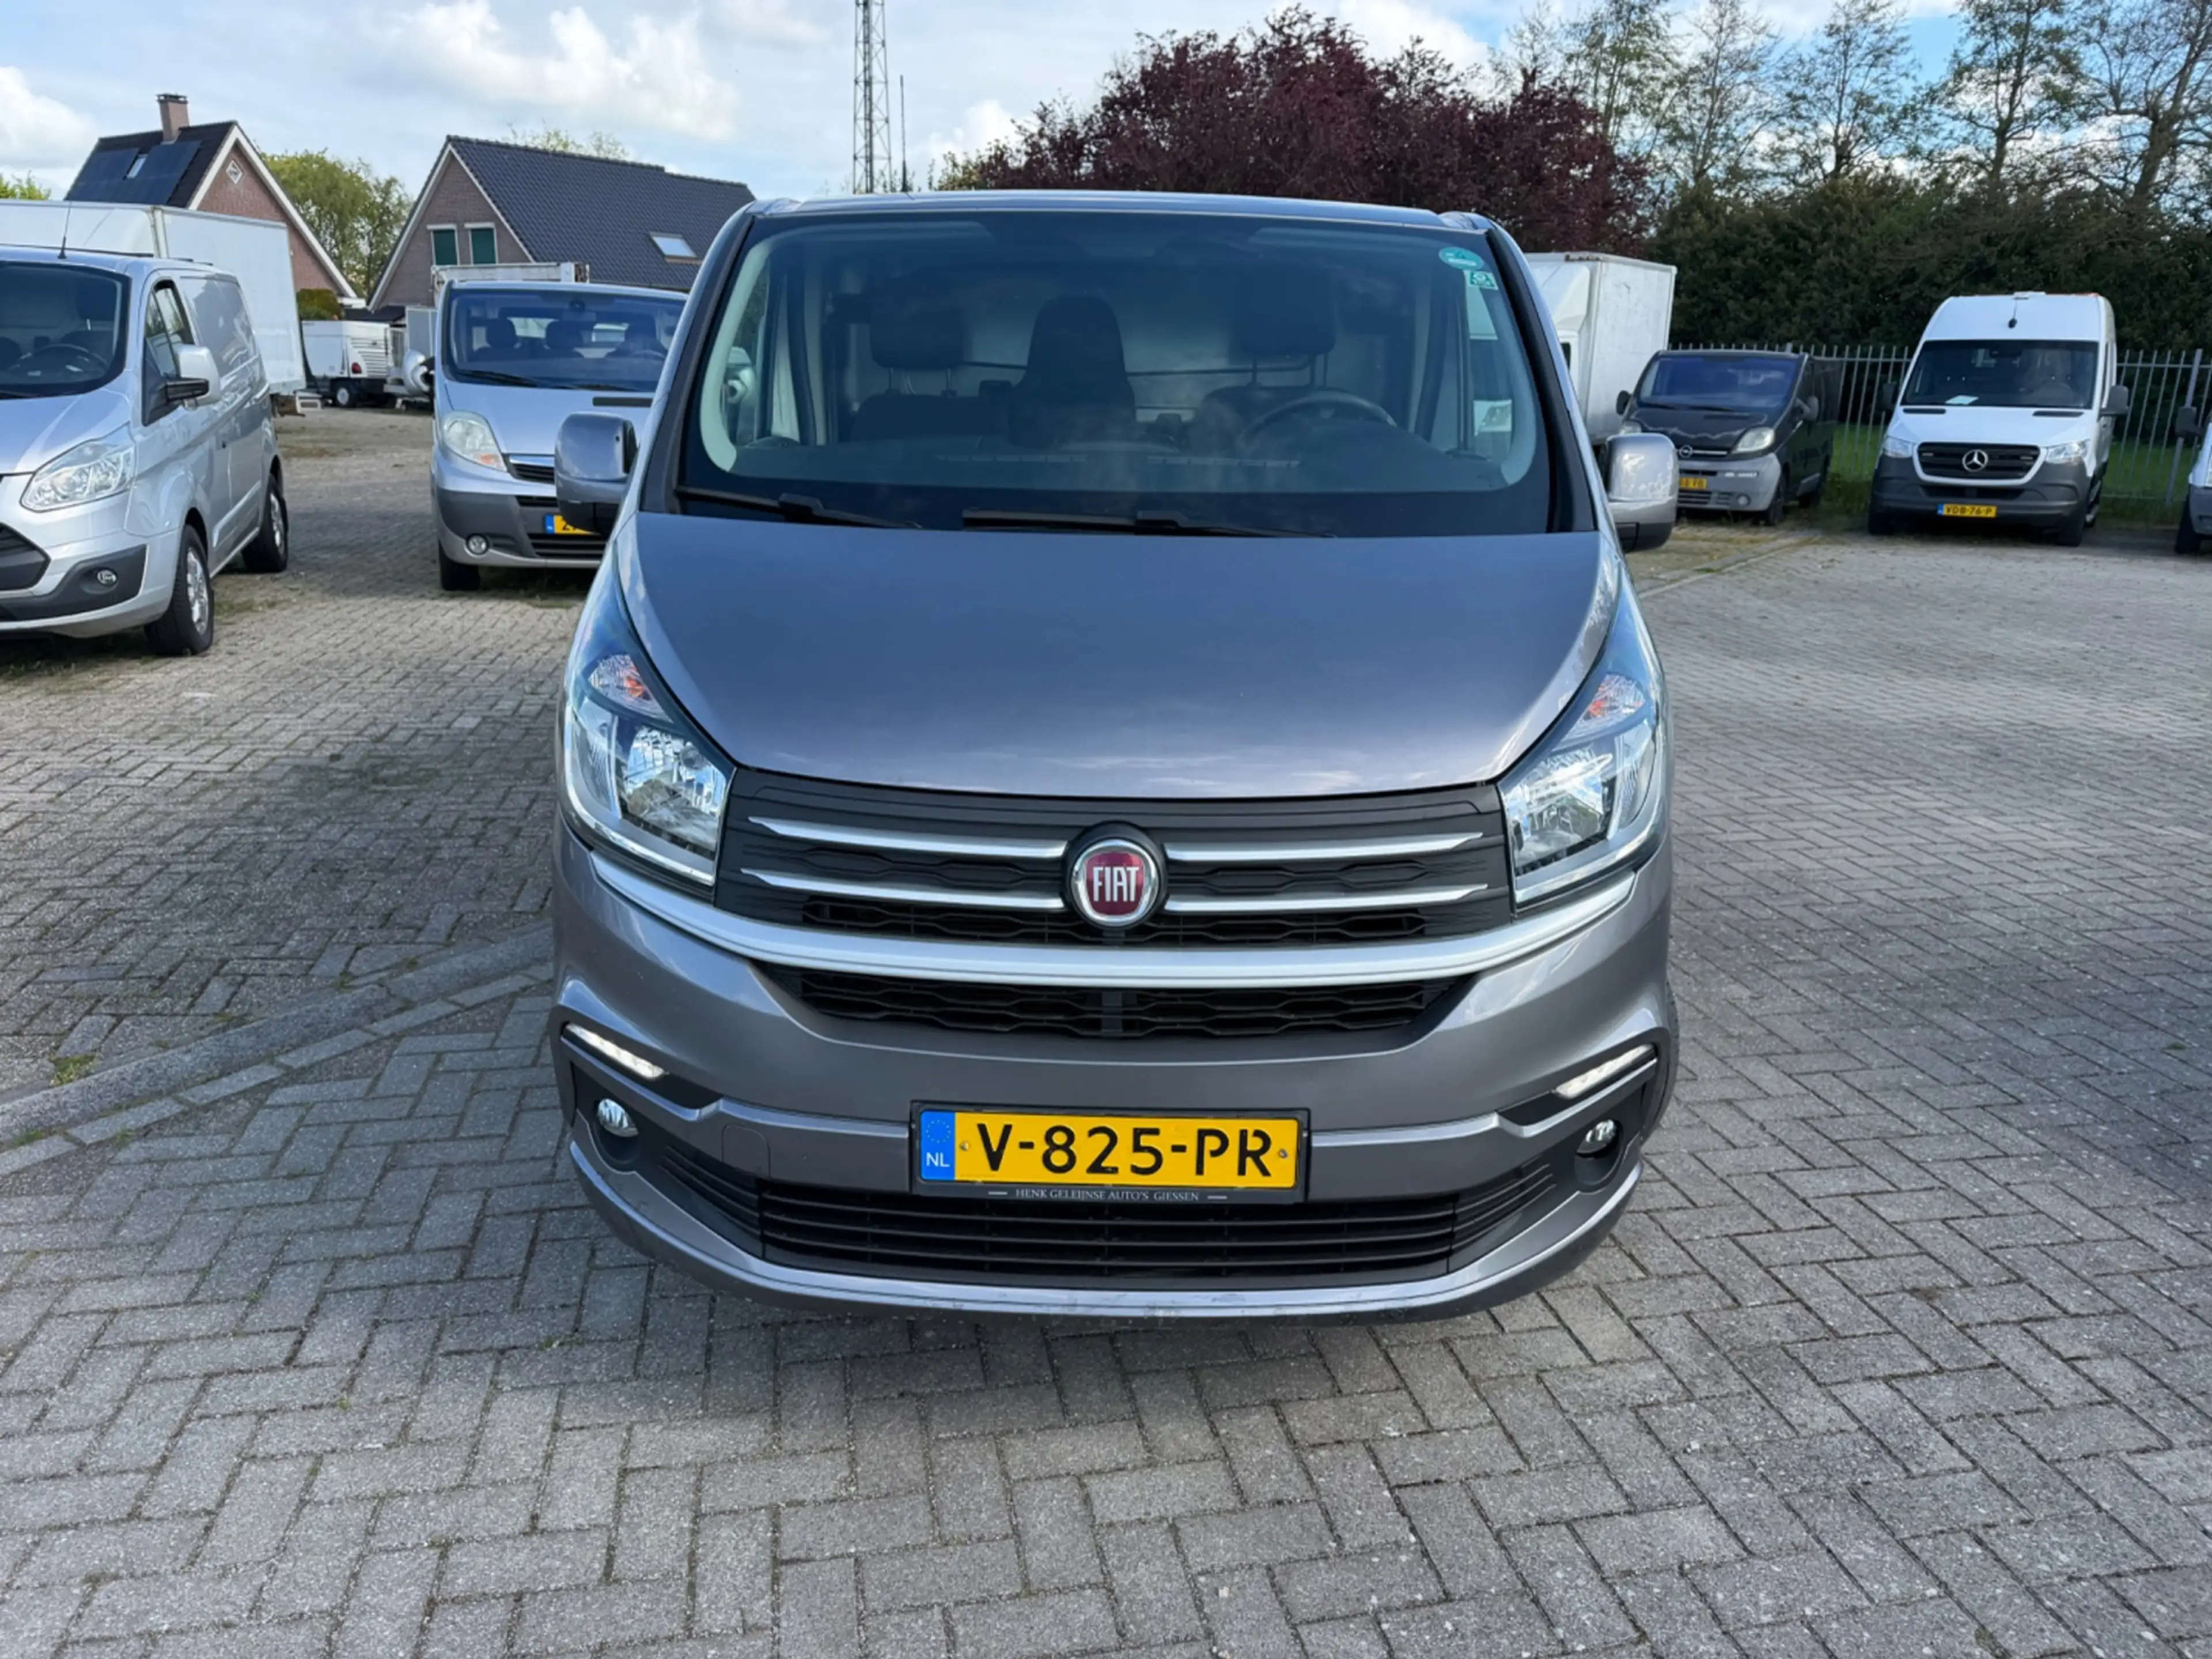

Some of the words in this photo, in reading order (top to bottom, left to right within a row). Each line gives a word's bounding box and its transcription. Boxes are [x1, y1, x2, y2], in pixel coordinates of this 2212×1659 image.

[1093, 866, 1139, 902] FIAT
[926, 1152, 950, 1168] NL
[977, 1123, 1271, 1177] V-825-PR
[1016, 1188, 1047, 1198] HENK
[1107, 1191, 1149, 1200] AUTO'S
[1153, 1191, 1199, 1201] GIESSEN
